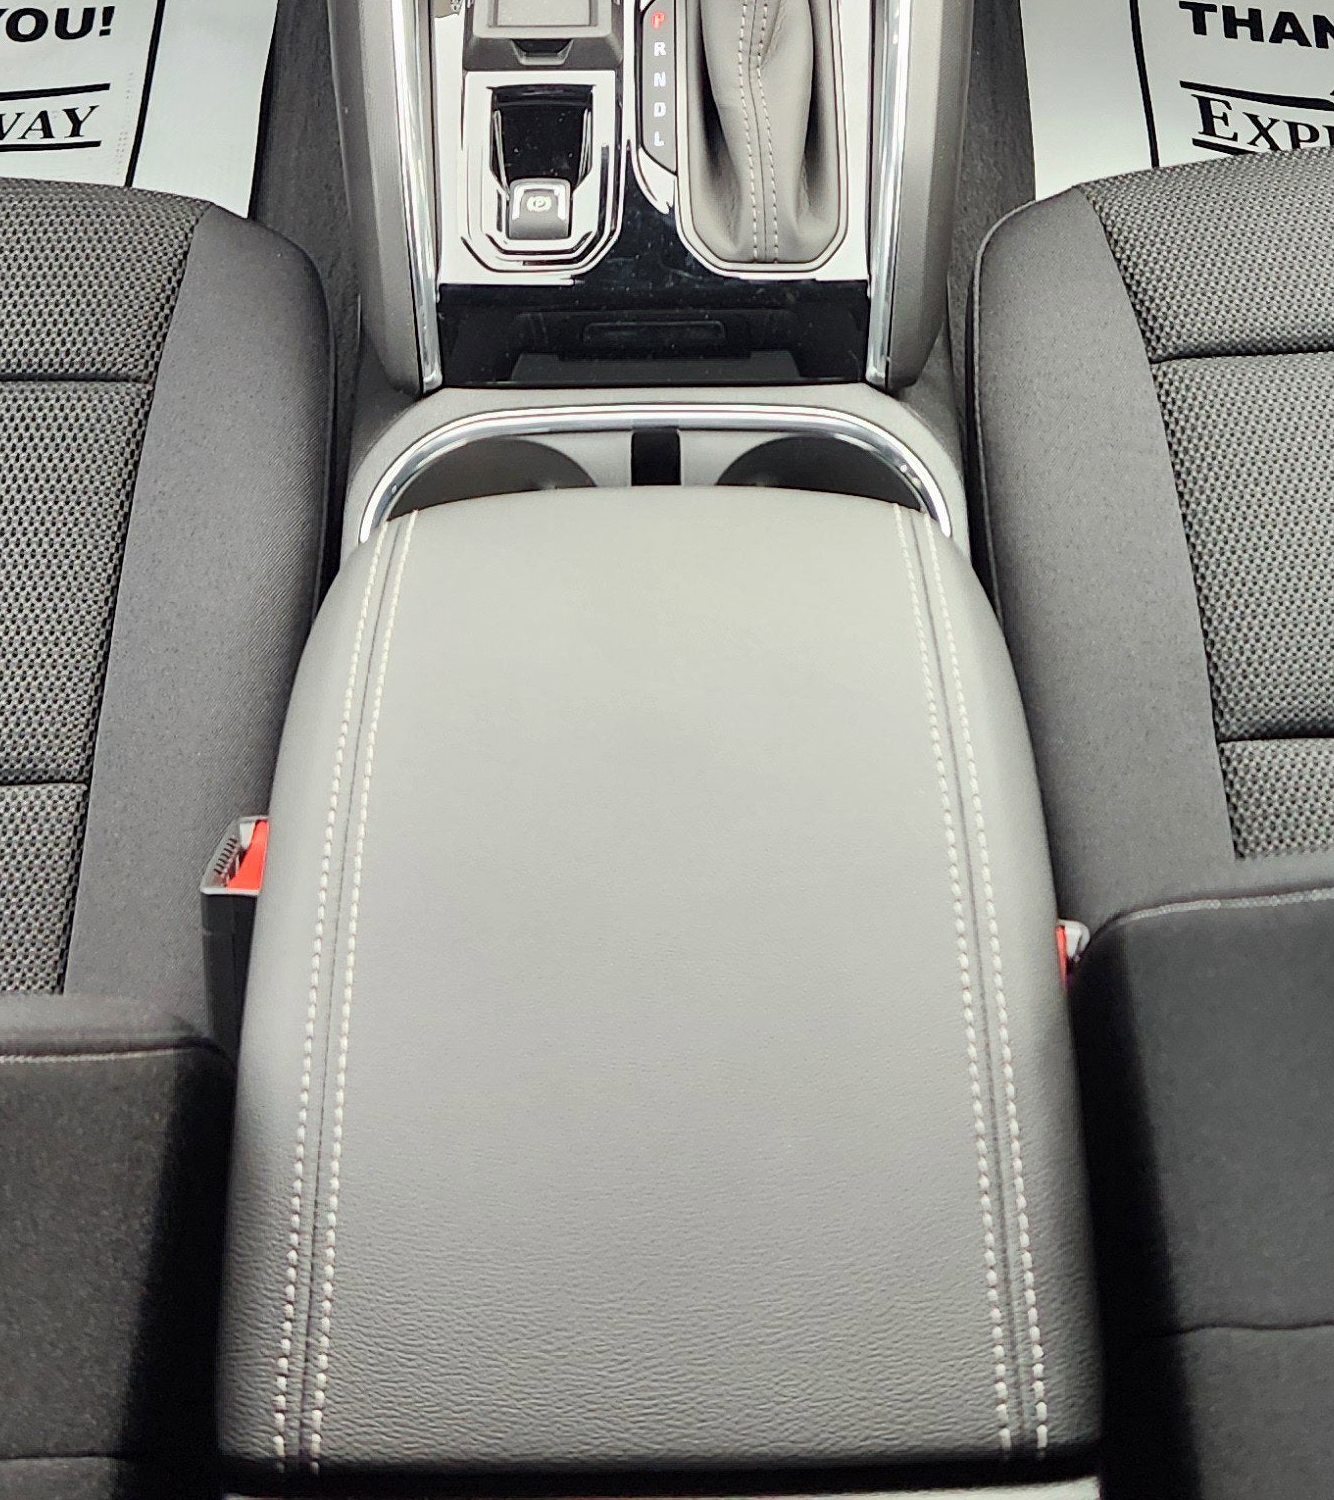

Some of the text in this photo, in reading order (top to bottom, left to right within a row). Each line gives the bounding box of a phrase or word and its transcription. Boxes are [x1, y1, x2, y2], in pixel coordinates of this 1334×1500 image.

[651, 11, 665, 31] P
[653, 41, 667, 57] R
[653, 71, 667, 88] N
[653, 101, 667, 118] D
[653, 130, 665, 147] L
